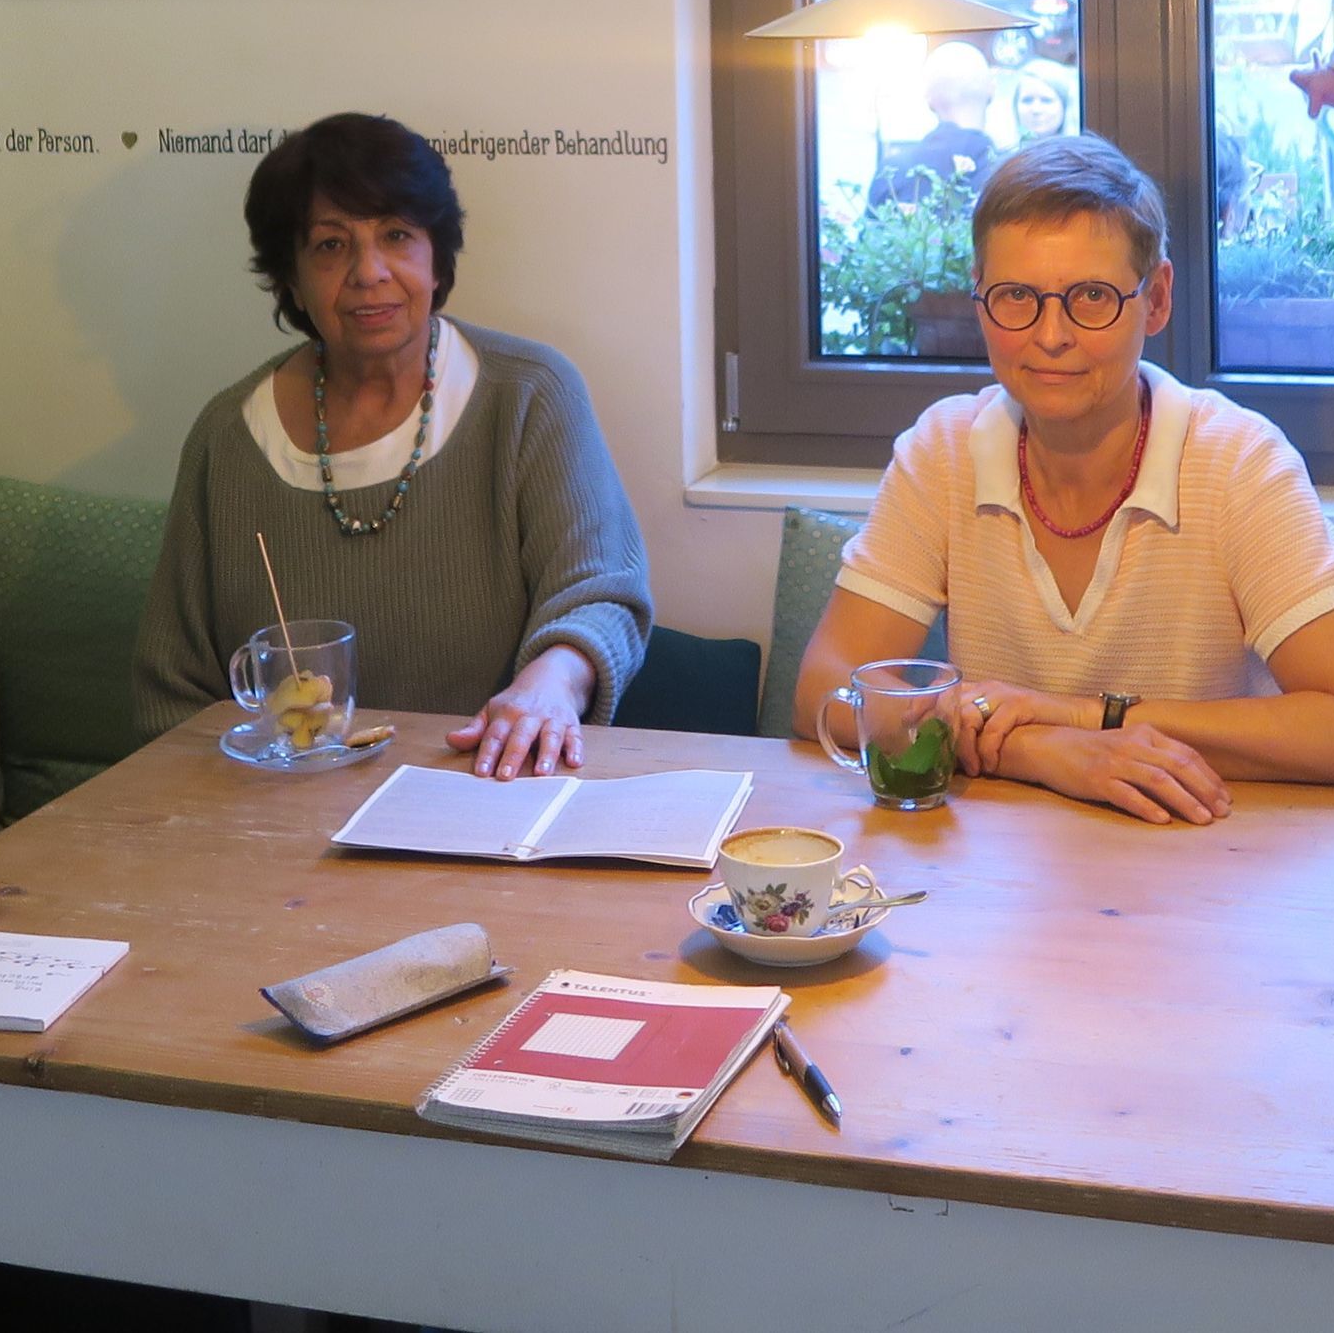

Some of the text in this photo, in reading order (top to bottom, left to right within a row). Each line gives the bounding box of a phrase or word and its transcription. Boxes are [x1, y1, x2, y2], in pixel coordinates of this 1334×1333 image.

[5, 128, 33, 154] der
[37, 128, 100, 155] Person.
[157, 128, 234, 155] Niemand
[237, 127, 273, 155] darf
[554, 129, 669, 165] Behandlung
[574, 983, 647, 997] TALENTUS
